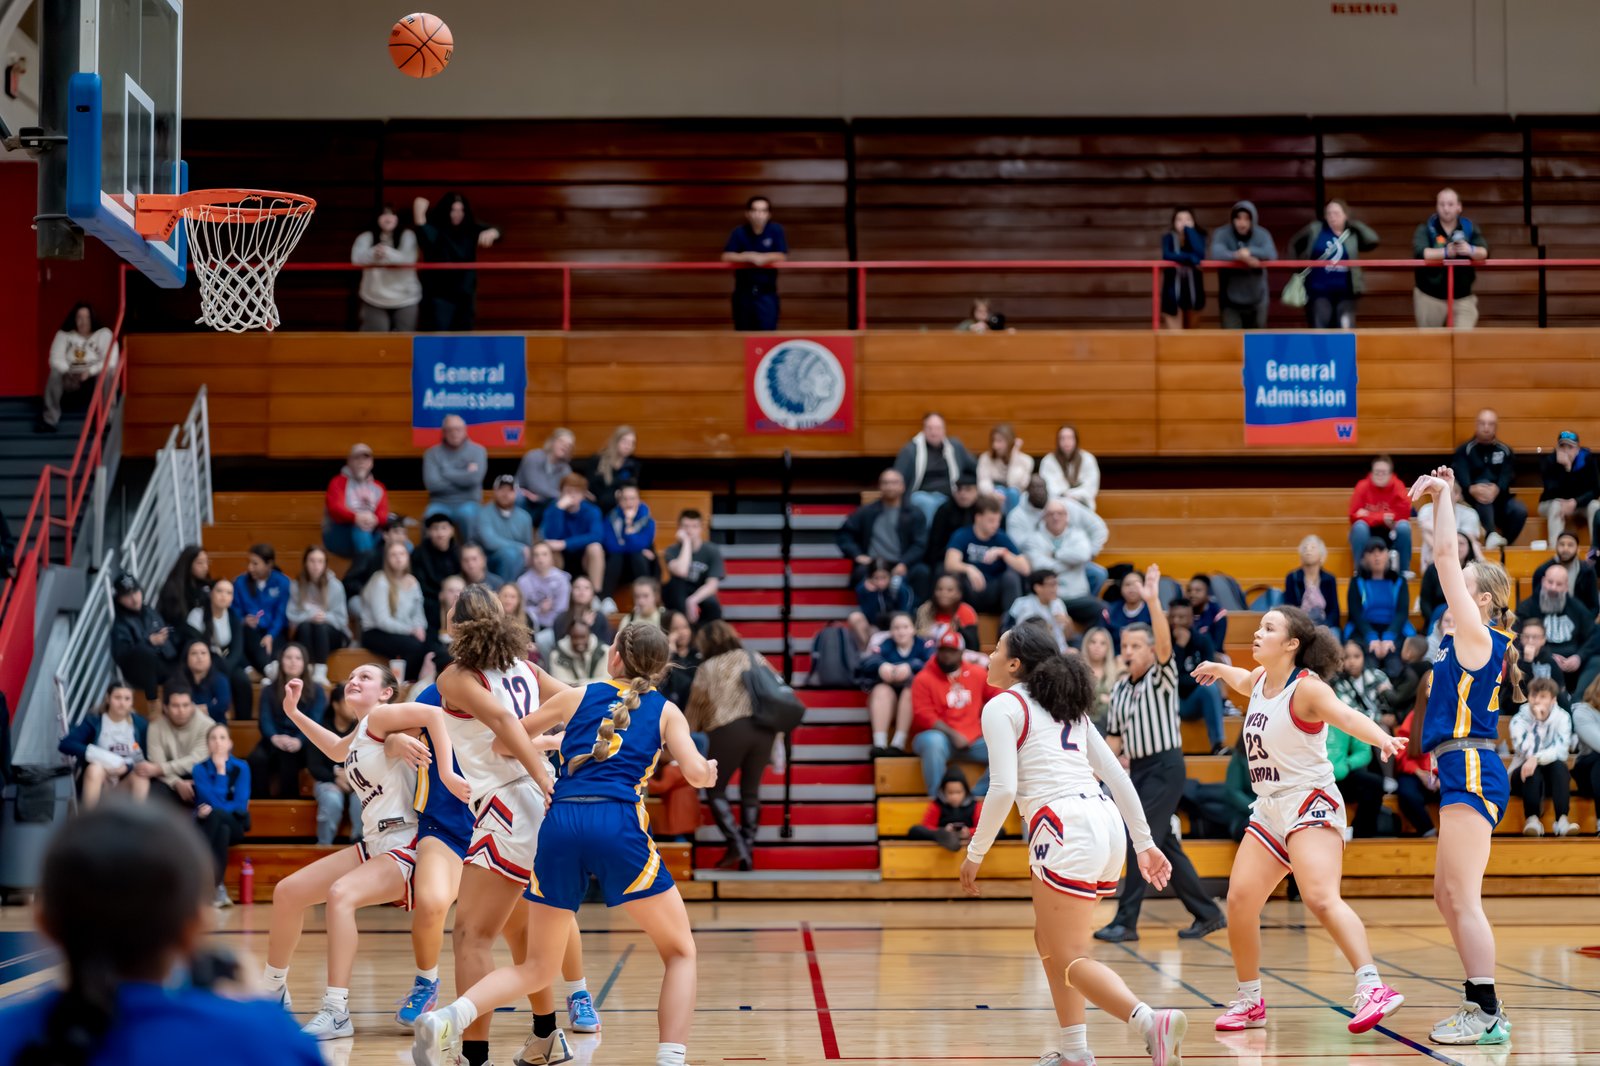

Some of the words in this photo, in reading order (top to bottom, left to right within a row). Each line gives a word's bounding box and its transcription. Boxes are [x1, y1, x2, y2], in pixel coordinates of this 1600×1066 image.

[1331, 3, 1398, 15] RESERVED
[433, 362, 505, 384] General
[1265, 360, 1336, 381] General
[422, 388, 515, 410] Admission
[1255, 385, 1346, 408] Admission
[1336, 424, 1354, 440] W
[502, 676, 531, 720] 12
[1245, 712, 1269, 731] WEST
[1054, 720, 1081, 751] 2
[1245, 732, 1269, 762] 23
[349, 767, 373, 793] 14
[1034, 843, 1050, 860] W
